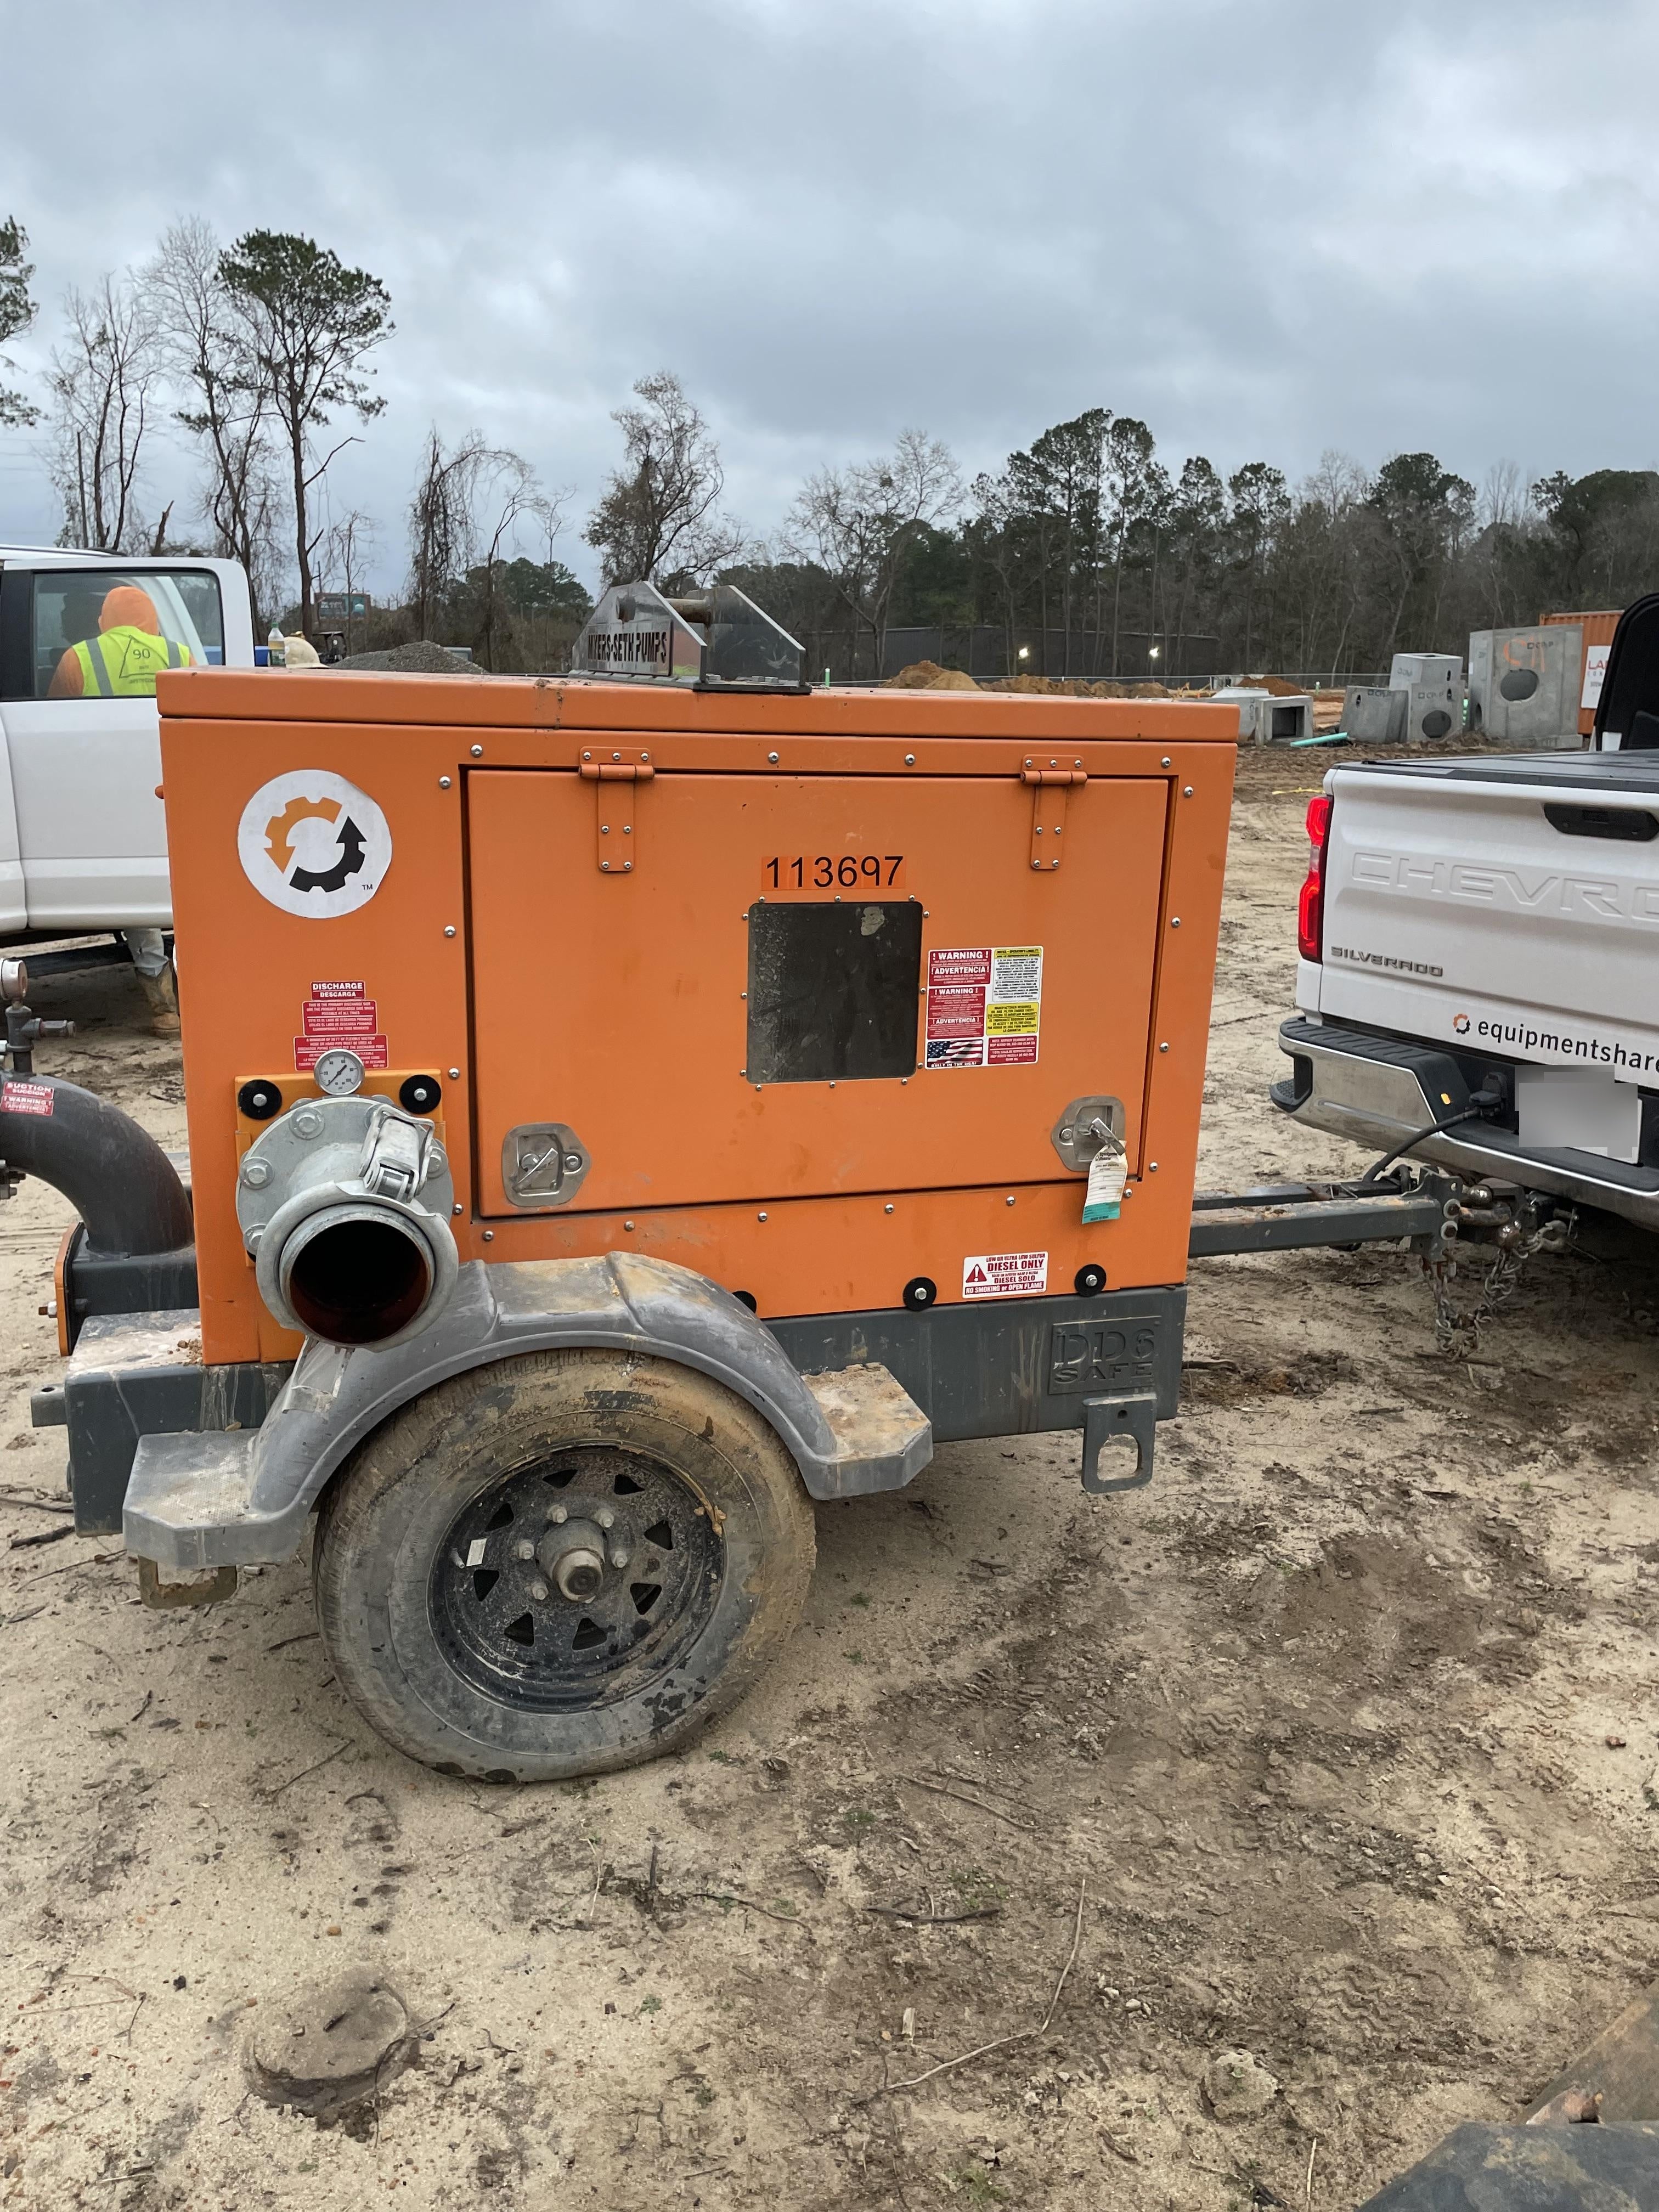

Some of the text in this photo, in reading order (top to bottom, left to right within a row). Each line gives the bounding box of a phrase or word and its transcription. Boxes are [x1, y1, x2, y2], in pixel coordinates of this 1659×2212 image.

[636, 631, 667, 663] PUMPS
[133, 649, 150, 659] 90
[767, 856, 903, 888] 113697
[938, 951, 983, 960] WARNING
[1331, 946, 1443, 977] SILVERADO
[934, 966, 986, 974] ADVERTENCIA
[7, 1082, 51, 1092] SUCTION
[9, 1097, 46, 1105] WARNING
[988, 1259, 1043, 1271] DIESEL ONLY
[1054, 1361, 1154, 1385] SAFE
